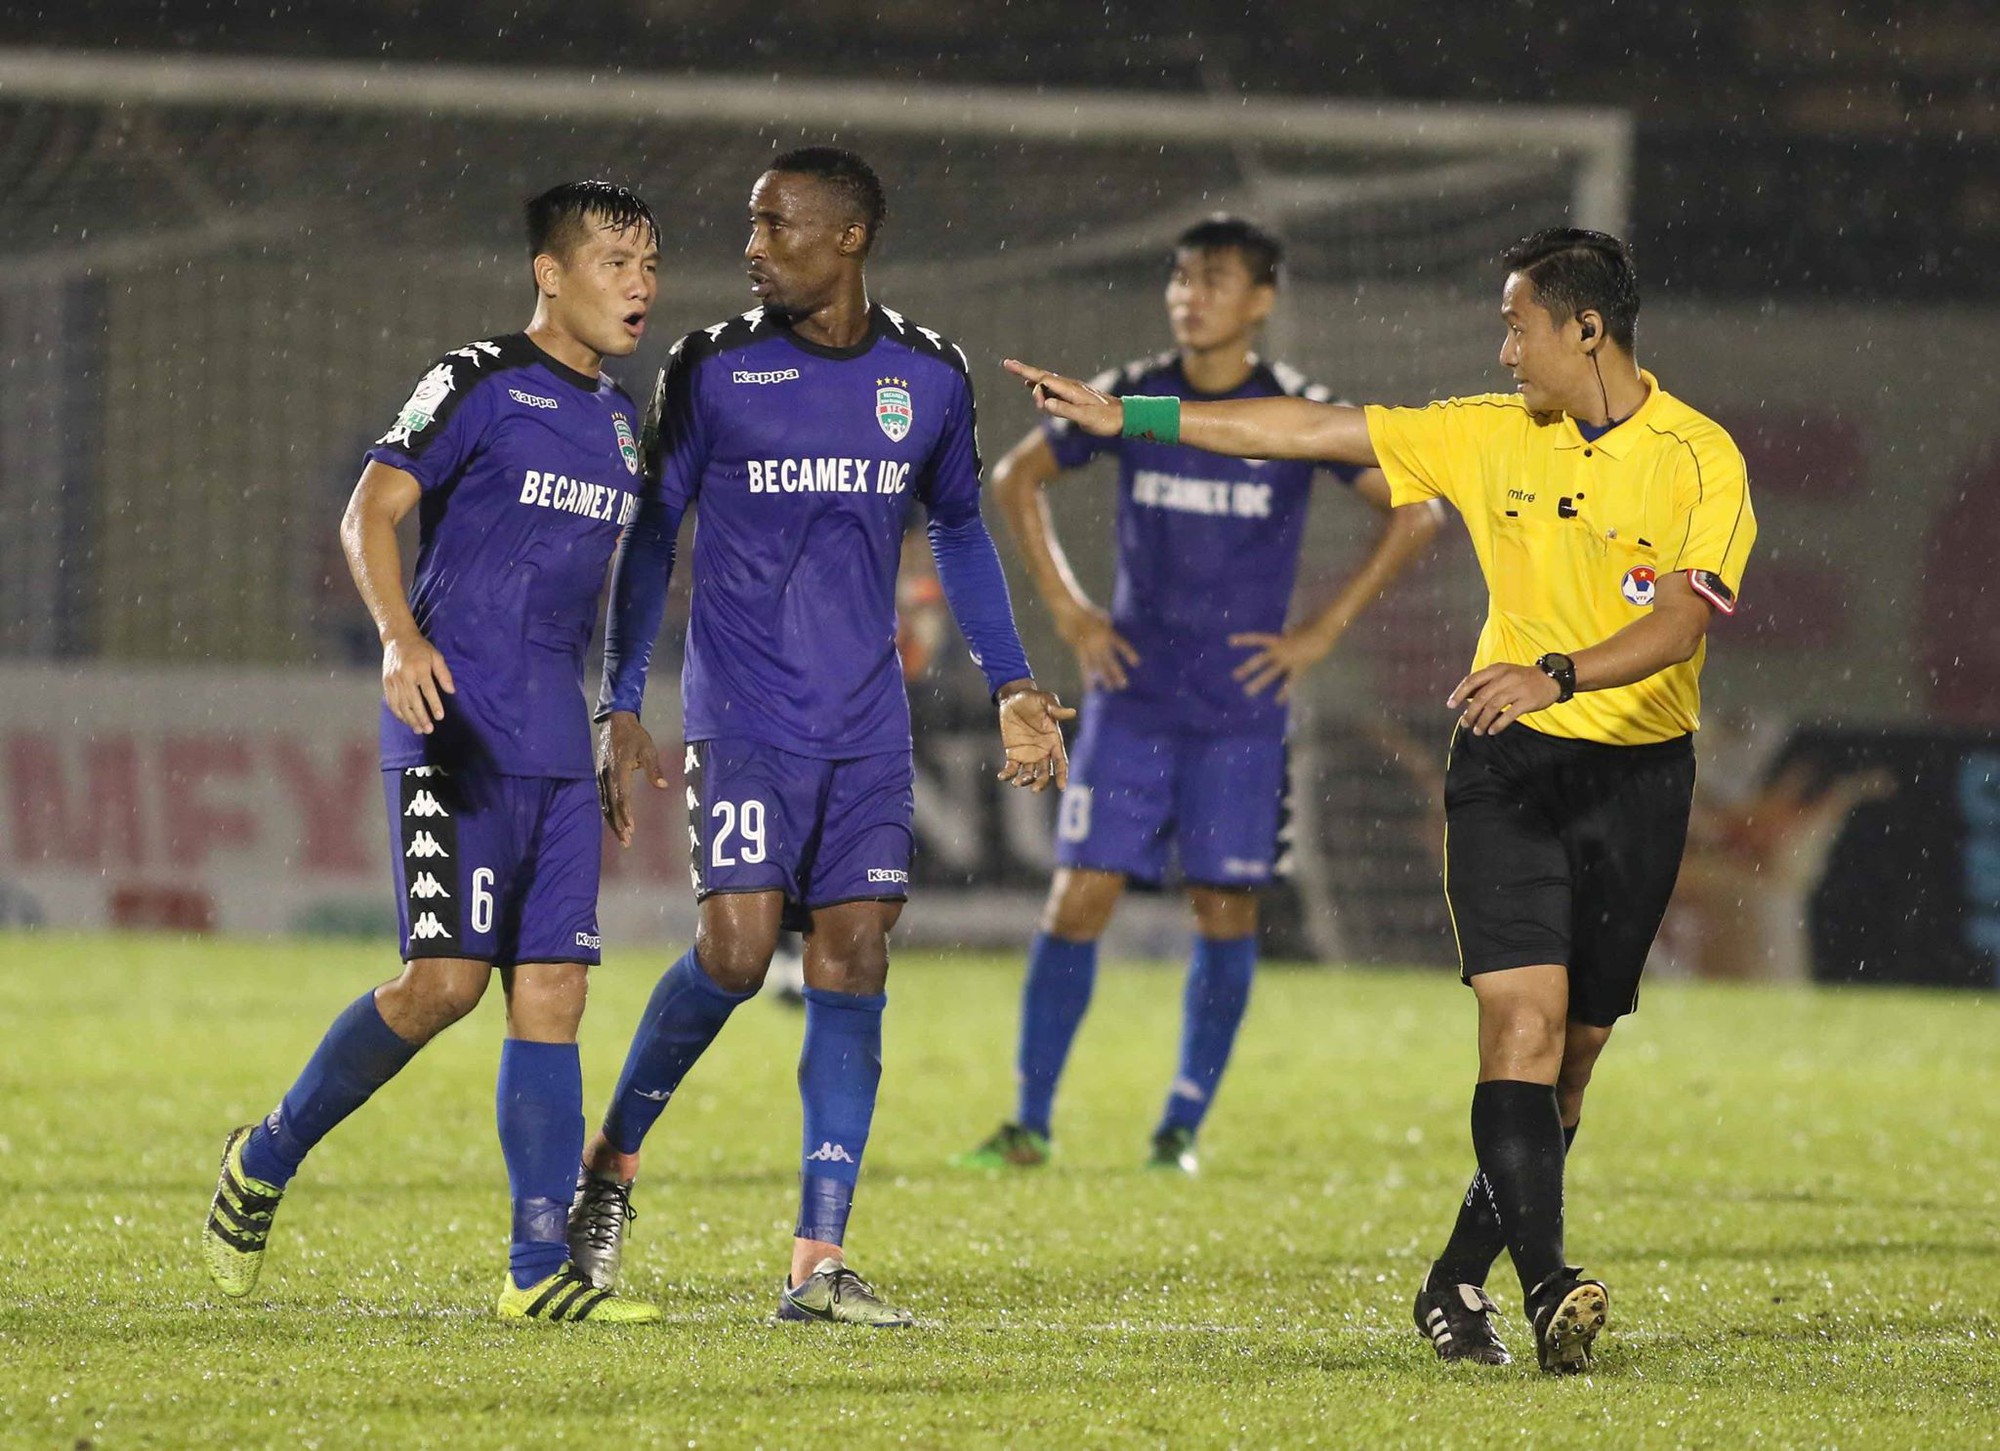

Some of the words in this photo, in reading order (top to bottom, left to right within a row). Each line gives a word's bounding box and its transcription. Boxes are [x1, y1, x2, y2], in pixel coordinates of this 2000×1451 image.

[733, 369, 799, 384] Kappa
[509, 389, 558, 408] Kappa
[748, 458, 870, 493] BECAMEX
[876, 460, 910, 494] IDC
[519, 470, 617, 521] BECAMEX
[616, 491, 637, 525] ID
[1508, 489, 1535, 503] mtre
[711, 800, 766, 868] 29
[868, 868, 909, 883] Kap
[471, 867, 494, 934] 6
[576, 932, 601, 949] Kapp
